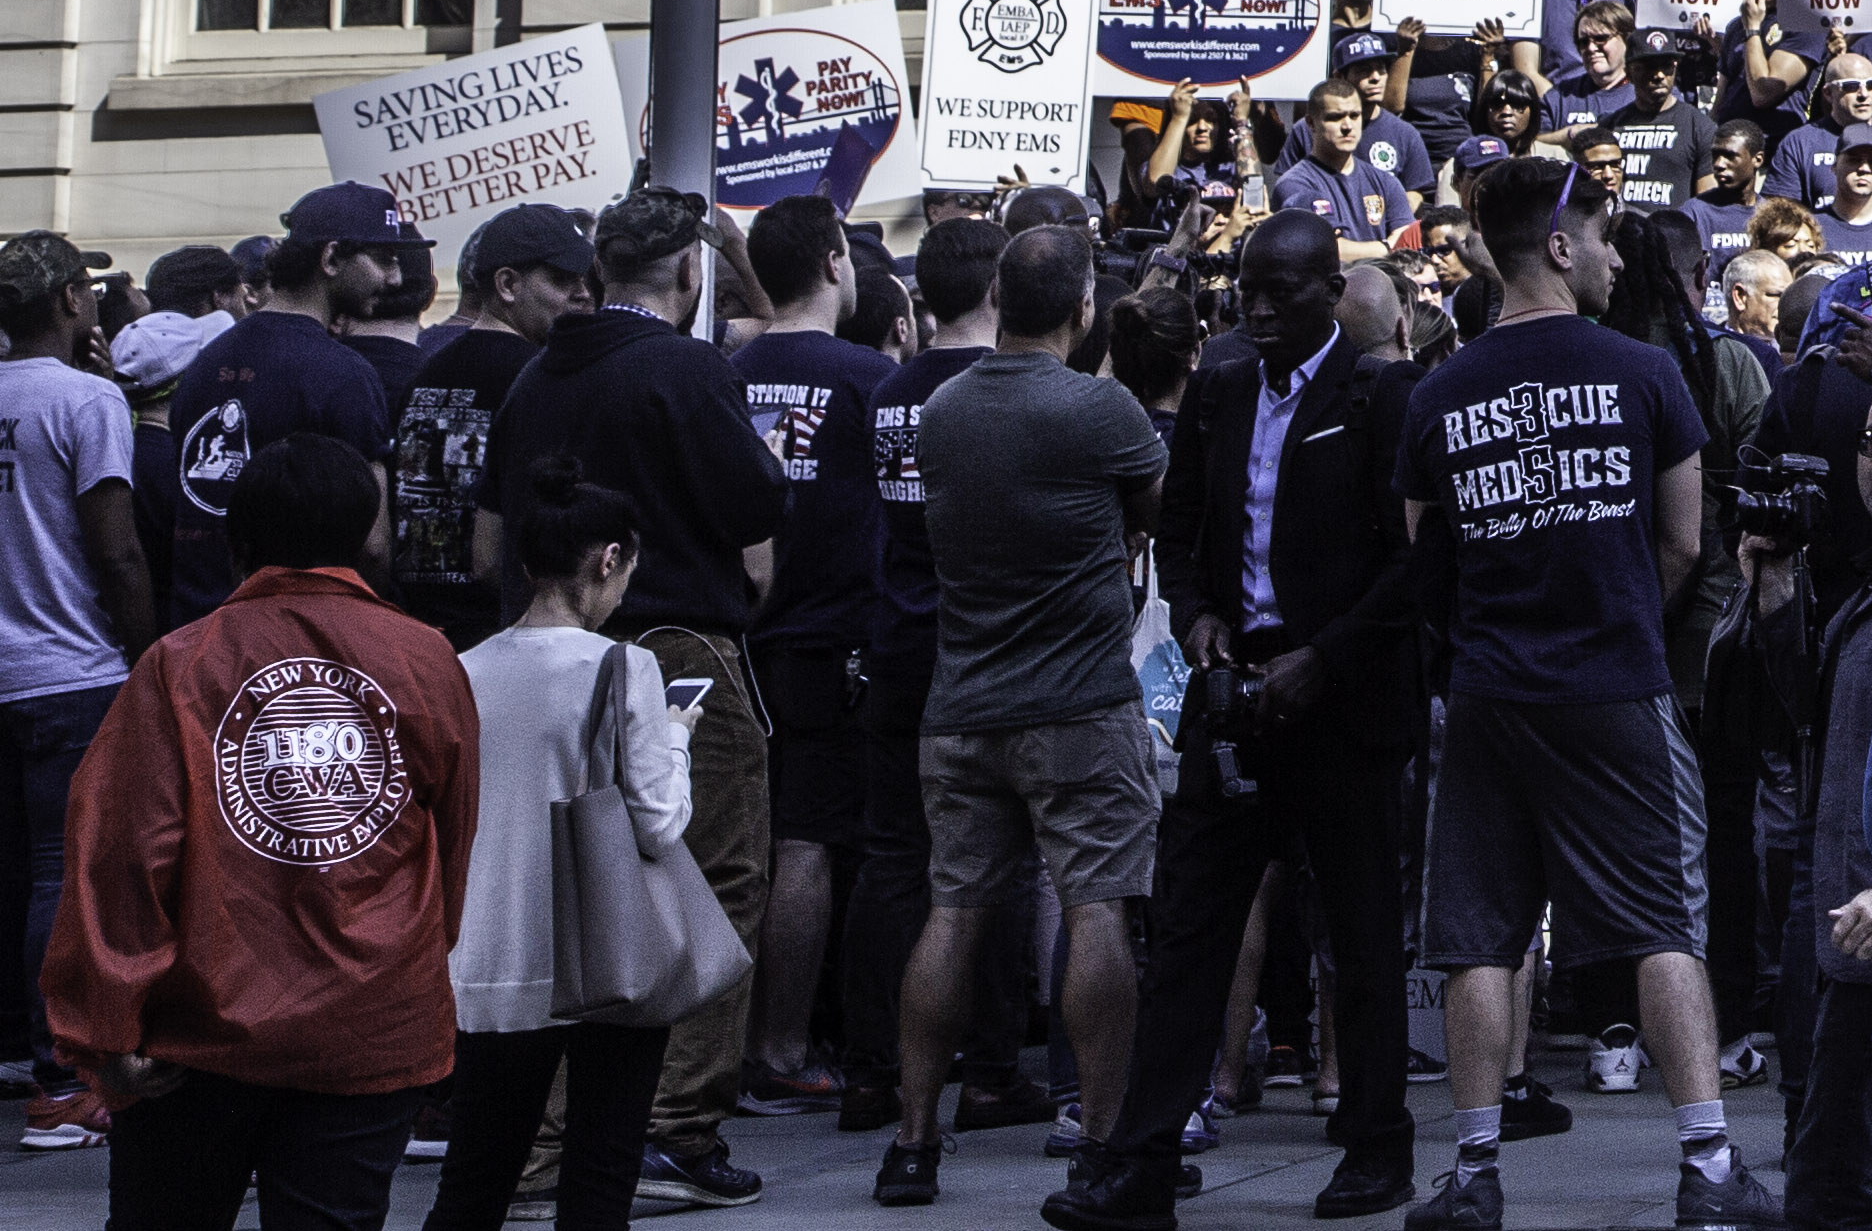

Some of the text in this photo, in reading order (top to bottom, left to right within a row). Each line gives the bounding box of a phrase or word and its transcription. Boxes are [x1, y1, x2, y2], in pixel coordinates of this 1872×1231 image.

[997, 4, 1035, 18] EMBA
[1240, 0, 1287, 13] NOW!
[1001, 21, 1030, 32] IAEP
[1131, 40, 1260, 51] www.emsworkisdifferent.com
[1144, 51, 1207, 60] Sponsored by local
[817, 57, 852, 77] PAY
[999, 54, 1024, 64] EMS
[354, 47, 583, 129] SAVING LIVES
[805, 71, 872, 96] PARITY
[816, 91, 865, 113] NOW!
[936, 97, 1078, 122] WE SUPPORT
[385, 82, 569, 152] EVERYDAY.
[948, 130, 1061, 153] FDNY EMS
[380, 120, 596, 195] WE DESERVE
[1626, 154, 1649, 174] MY
[397, 150, 596, 223] BETTER PAY.
[1623, 181, 1672, 205] CHECK
[747, 384, 832, 407] STATION 17
[1461, 499, 1635, 541] The Belly Of The Beast
[247, 664, 375, 703] NEW YORK
[259, 722, 366, 768] 1180
[263, 762, 373, 803] CWA
[221, 738, 351, 857] ADMINISTRATIVE
